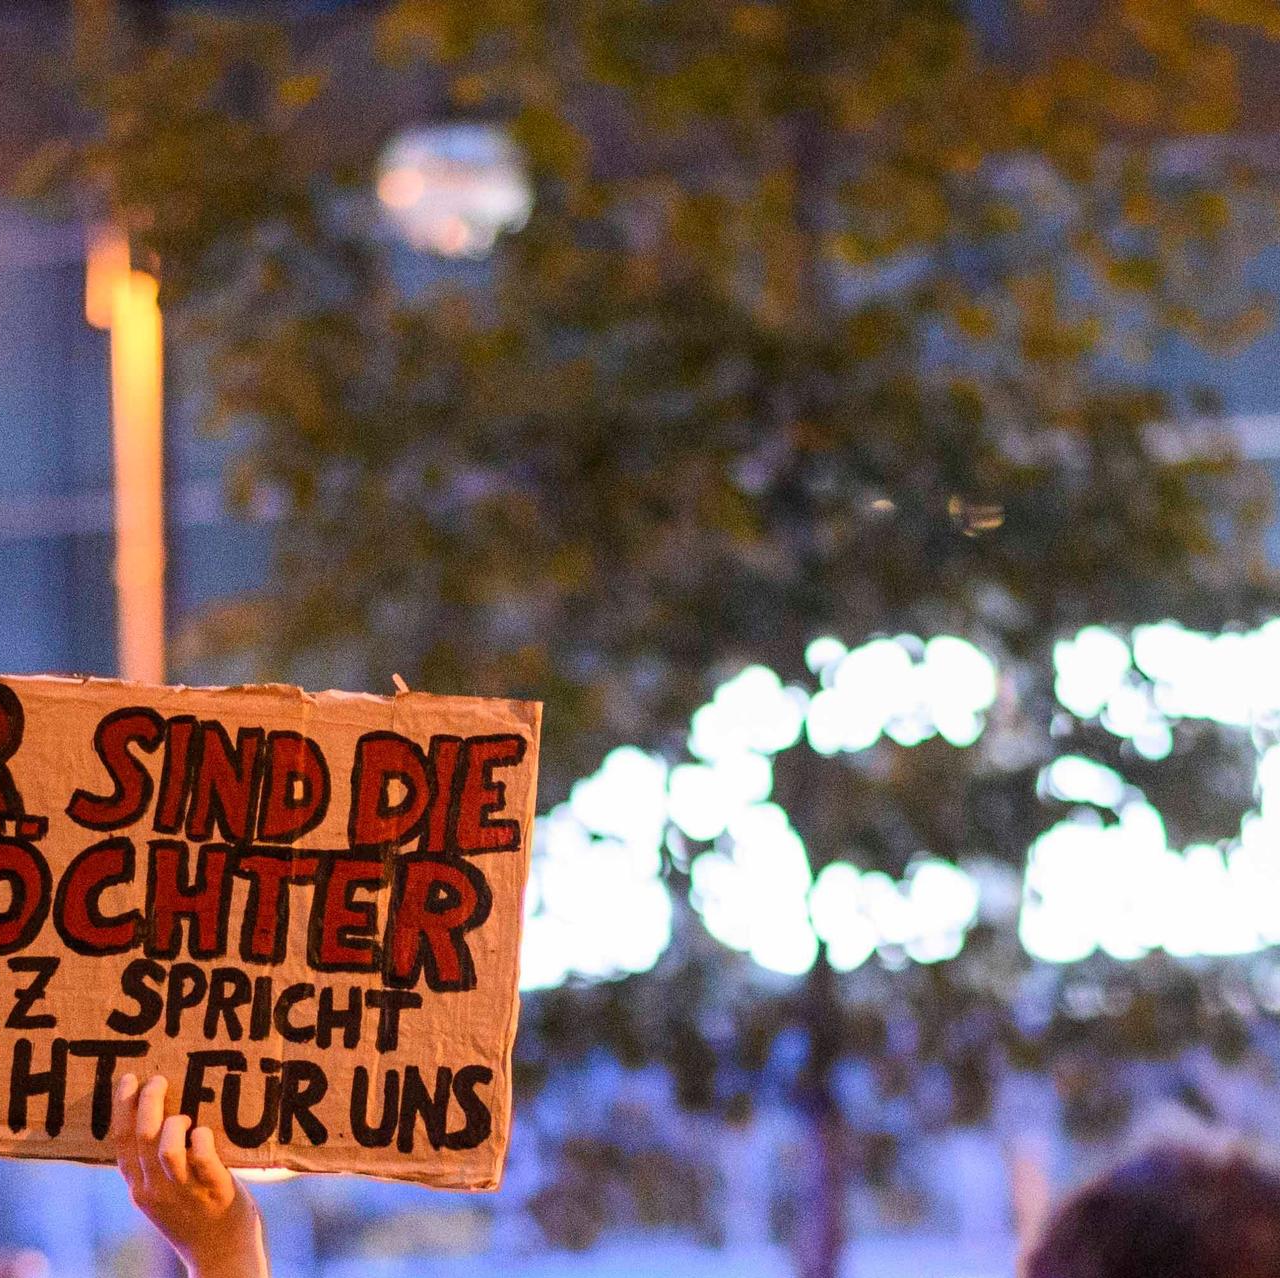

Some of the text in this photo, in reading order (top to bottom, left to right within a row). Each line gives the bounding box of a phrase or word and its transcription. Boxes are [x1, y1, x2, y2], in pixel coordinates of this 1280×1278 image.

[66, 707, 331, 844] SIND
[348, 731, 527, 853] DIE
[107, 960, 422, 1052] SPRICHT
[180, 1050, 329, 1150] FÜR
[350, 1064, 492, 1151] UNS
